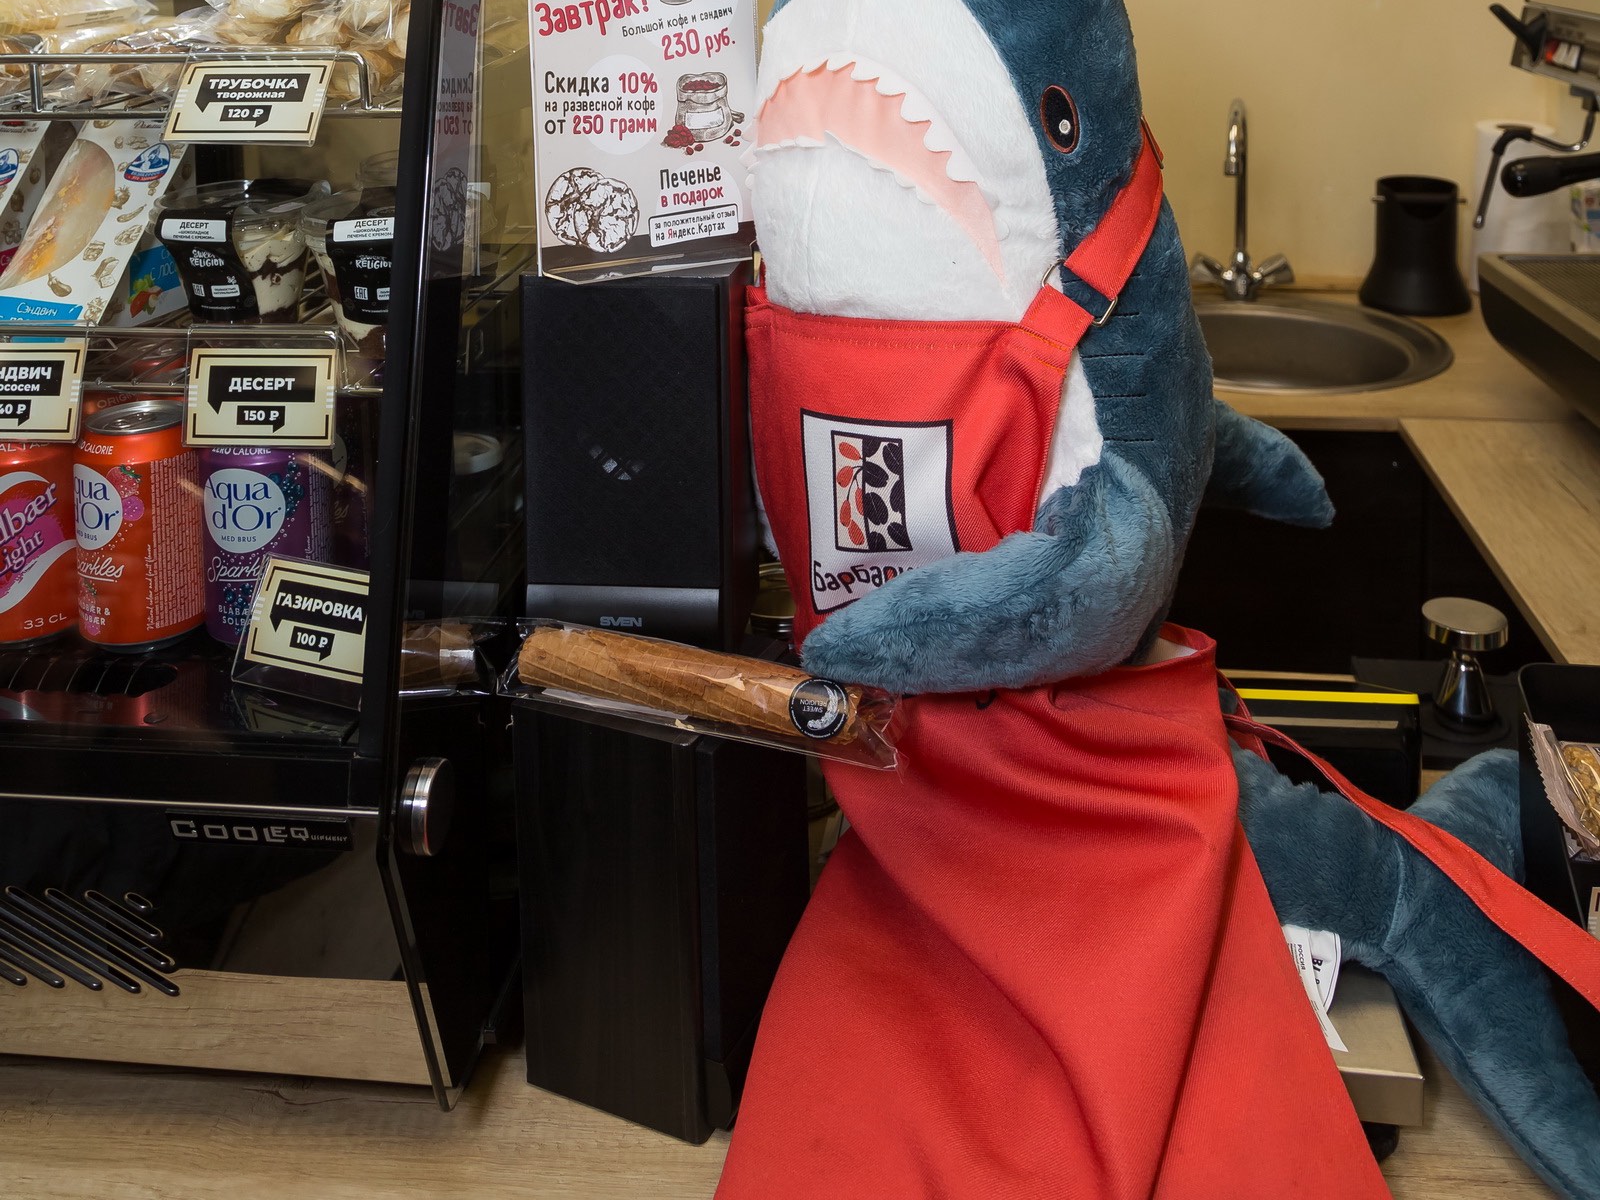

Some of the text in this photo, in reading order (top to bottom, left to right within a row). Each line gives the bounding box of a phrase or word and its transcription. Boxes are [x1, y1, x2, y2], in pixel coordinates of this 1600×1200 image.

[622, 7, 733, 37] Большой кофе и сандвич
[661, 27, 735, 61] 230 руб.
[208, 77, 299, 90] ТРУБОЧКА
[545, 71, 657, 96] Скидка 10%
[217, 90, 285, 100] творожная
[227, 107, 250, 119] 120
[545, 96, 655, 117] на развесной кофе
[545, 115, 657, 141] от 250 грамм
[660, 165, 722, 190] Печенье
[661, 186, 724, 208] в подарок
[355, 219, 388, 228] ДЕСЕРТ
[654, 210, 735, 229] за положительный отзыв
[655, 222, 725, 241] на Яндекс.Картах
[17, 302, 58, 316] Сэндвич
[0, 367, 52, 381] НДВИЧ
[229, 377, 295, 393] ДЕСЕРТ
[0, 404, 13, 414] 40
[243, 410, 265, 421] 150
[84, 443, 113, 455] CALORIE
[74, 476, 110, 505] qua
[206, 476, 272, 509] Aqua
[84, 532, 97, 541] BRUS
[0, 531, 43, 573] ight
[208, 557, 260, 582] Spark
[276, 592, 363, 621] ГАЗИРОВКА
[24, 613, 67, 630] 33 CL
[600, 616, 642, 627] SVEN
[296, 632, 319, 645] 100
[1297, 944, 1305, 970] РОССИЯ
